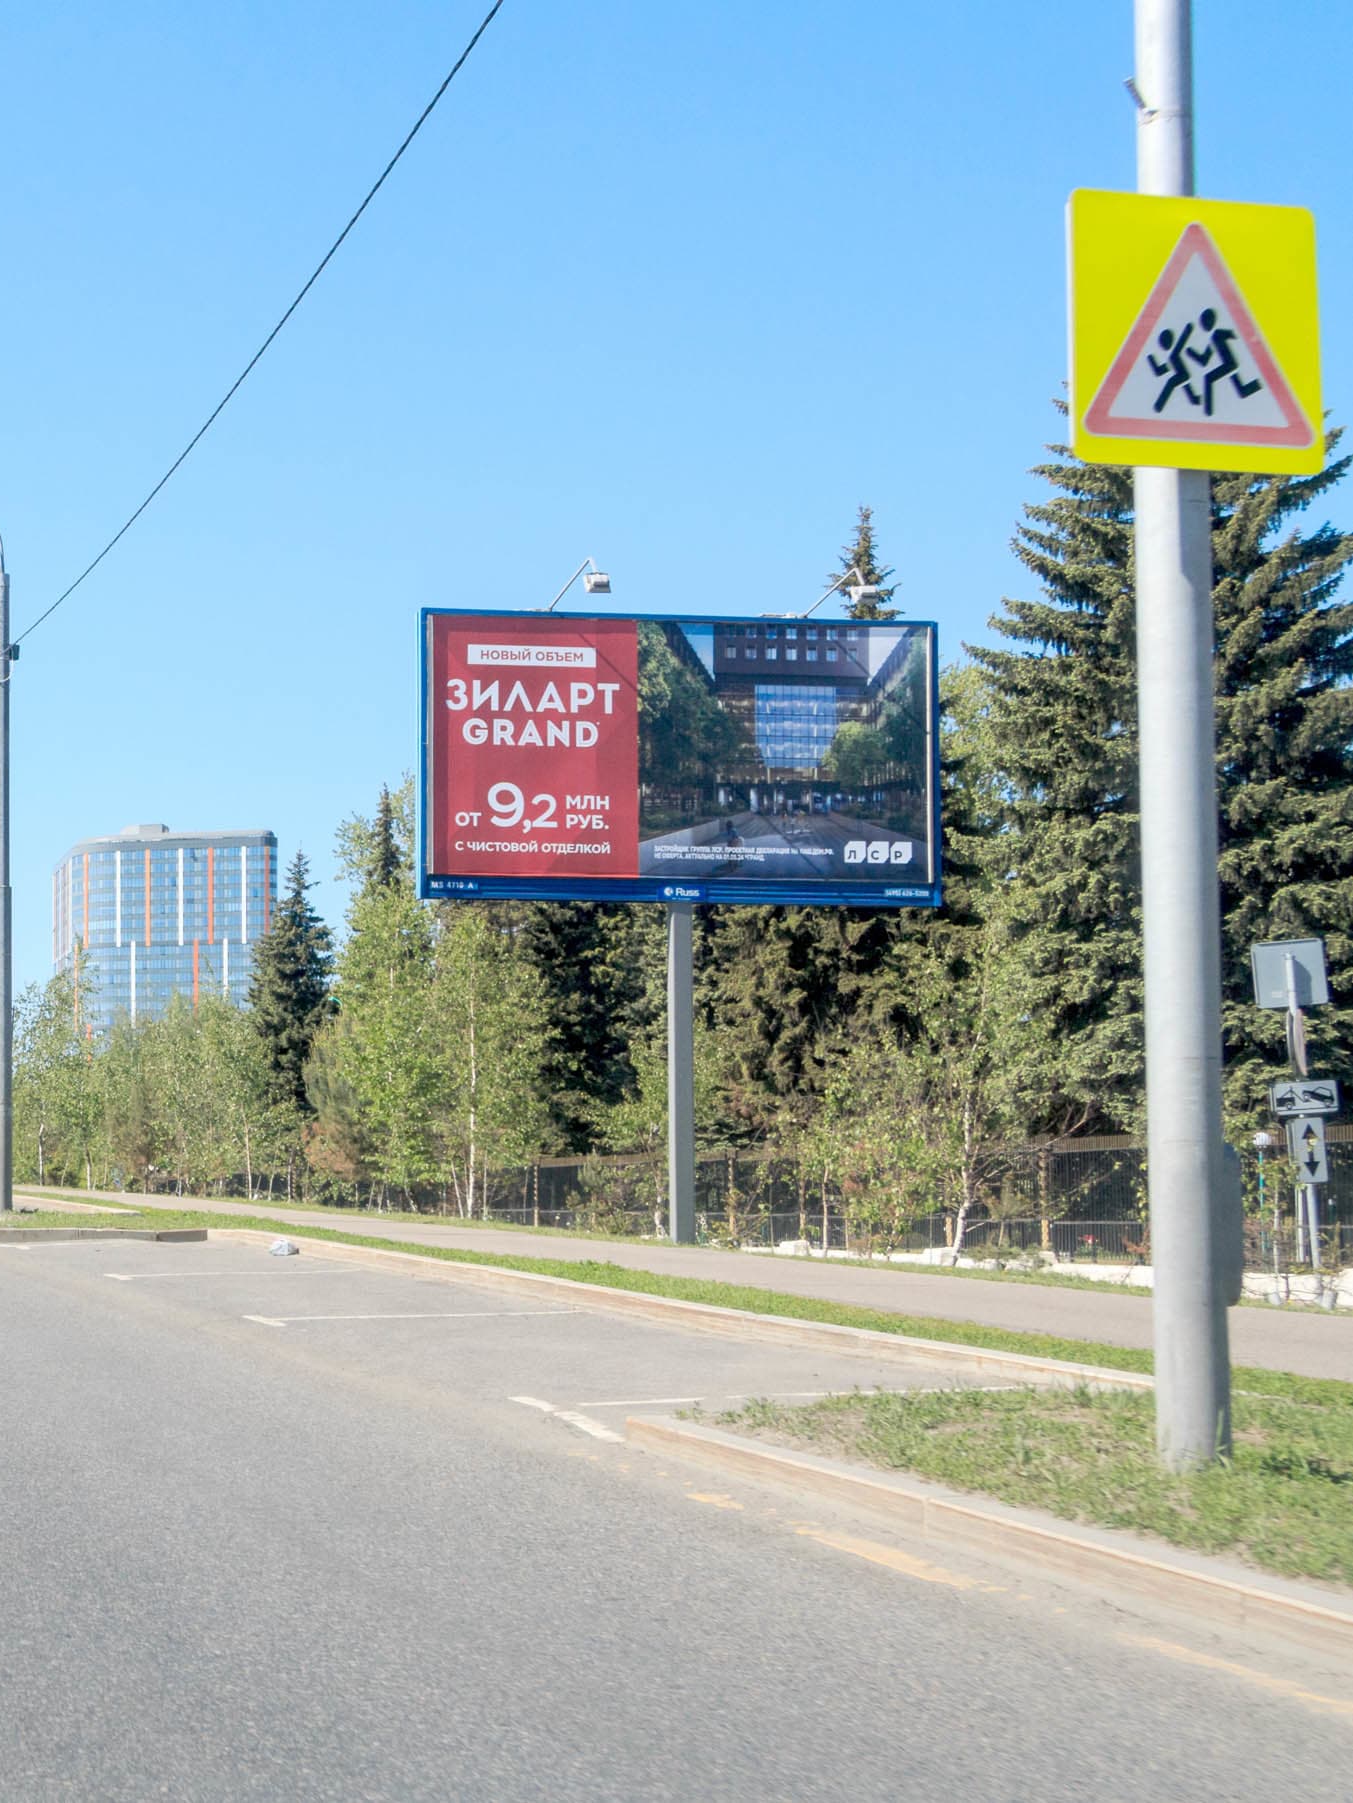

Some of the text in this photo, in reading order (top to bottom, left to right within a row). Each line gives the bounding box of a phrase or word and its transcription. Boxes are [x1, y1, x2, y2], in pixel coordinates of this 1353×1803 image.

[480, 648, 584, 662] НОВЫЙ ОБЪЕМ
[446, 678, 620, 714] ЗИЛАРТ
[462, 718, 599, 748] GRAND
[455, 782, 558, 834] ОТ 9,2
[566, 795, 610, 810] МЛН
[566, 814, 610, 830] РУБ.
[455, 840, 611, 855] С ЧИСТОВОЙ ОТДЕЛКОЙ
[846, 846, 907, 862] ЛСР
[675, 887, 700, 896] Russ
